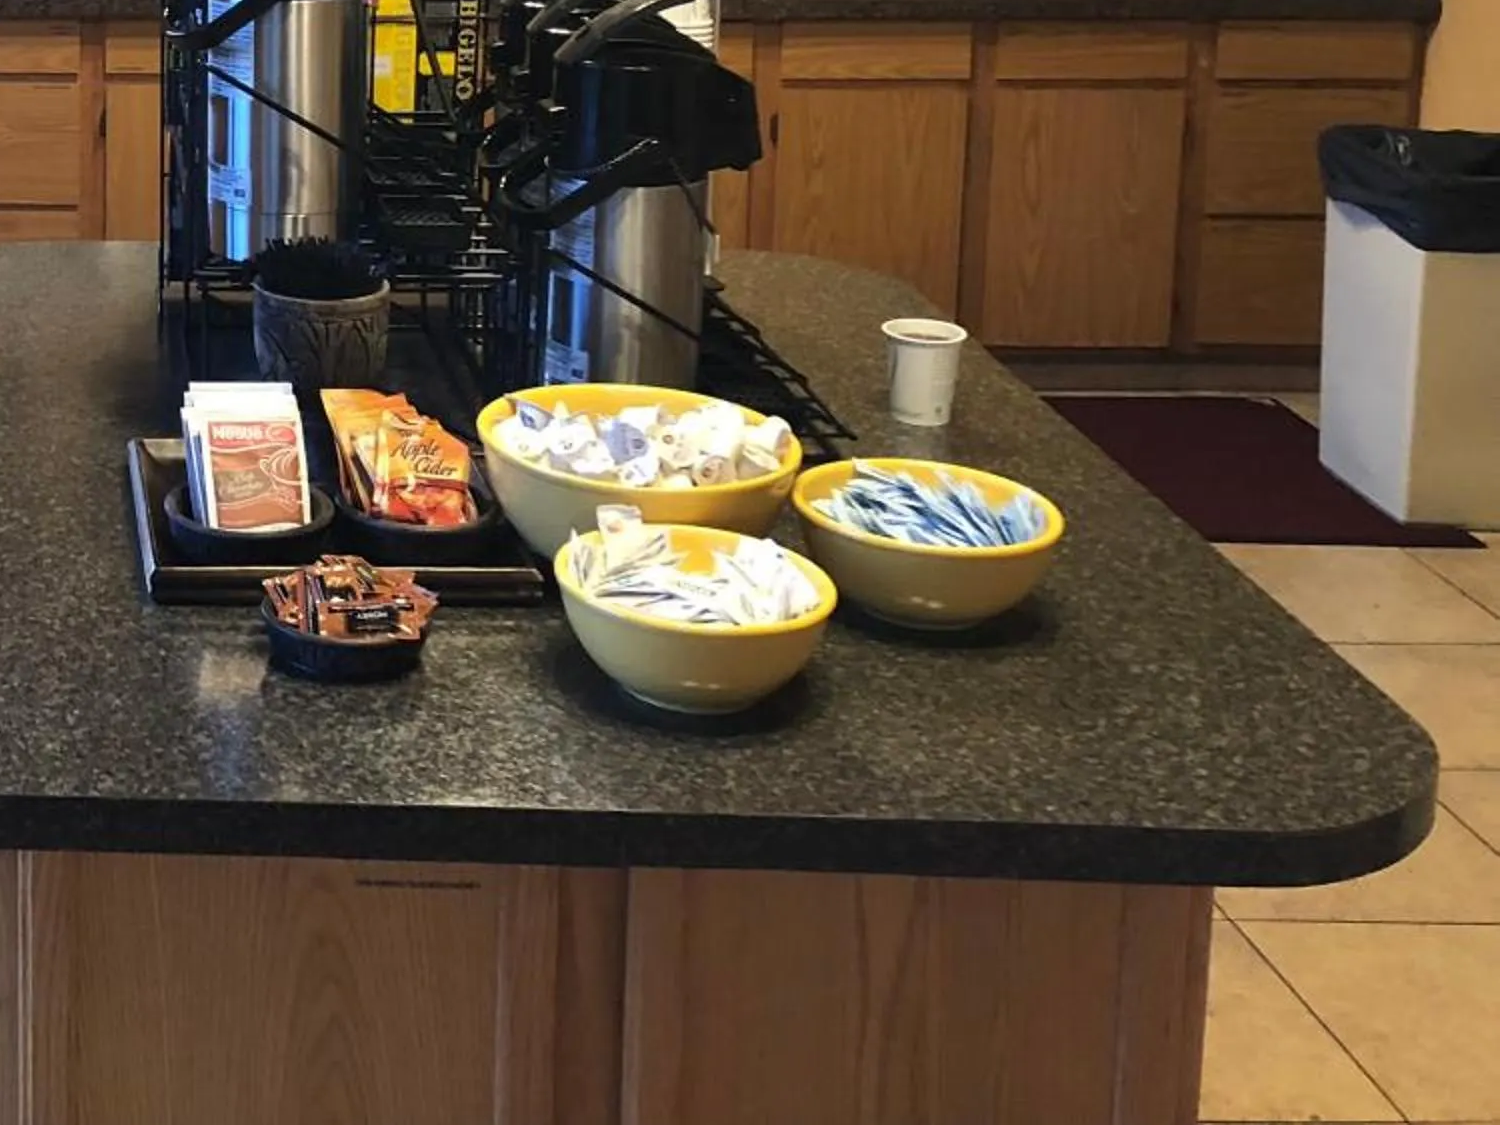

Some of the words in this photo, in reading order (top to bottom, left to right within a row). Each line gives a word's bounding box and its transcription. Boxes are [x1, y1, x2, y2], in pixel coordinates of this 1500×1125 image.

[456, 0, 479, 101] BIGELO
[389, 438, 440, 462] Apple
[414, 457, 459, 476] Cider
